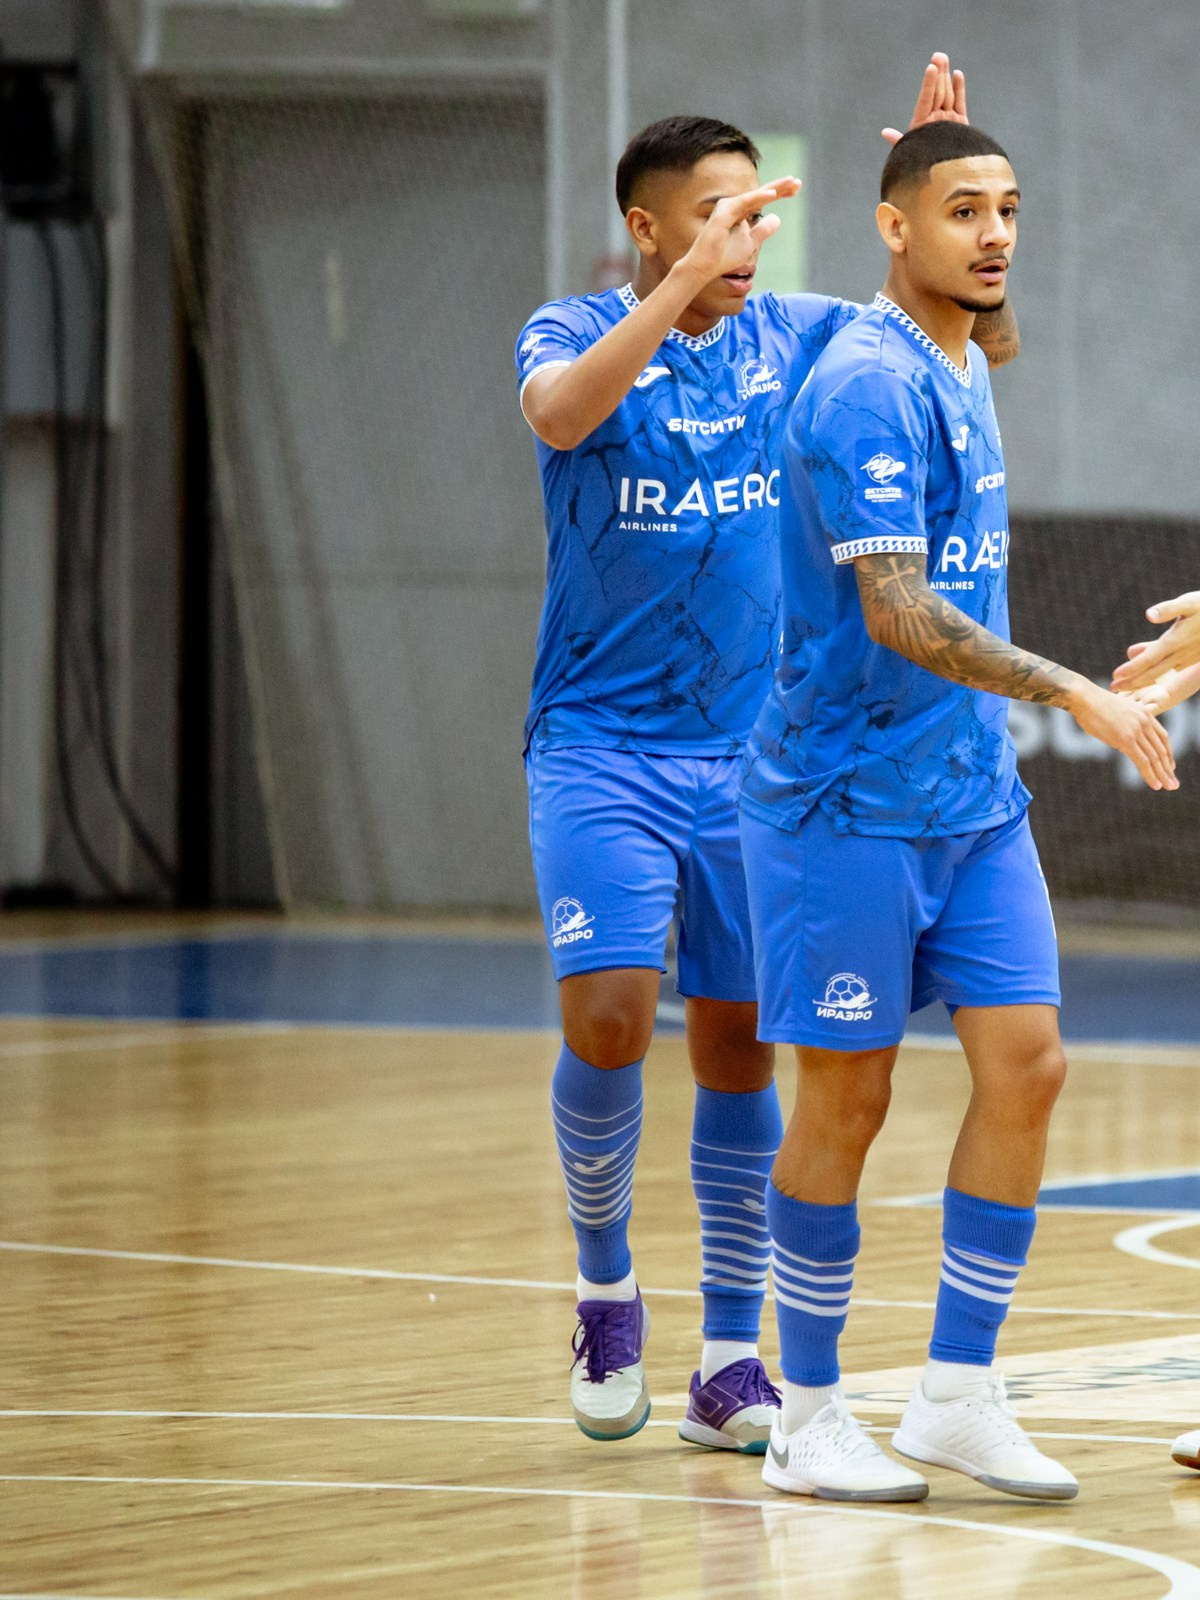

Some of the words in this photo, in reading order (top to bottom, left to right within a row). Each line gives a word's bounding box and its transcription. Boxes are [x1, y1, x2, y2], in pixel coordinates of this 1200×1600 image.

[667, 414, 746, 436] БЕТСИТИ
[618, 521, 678, 533] AIRLINES
[929, 581, 975, 591] AIRLINES
[816, 1006, 873, 1022] ИРАЭРО
